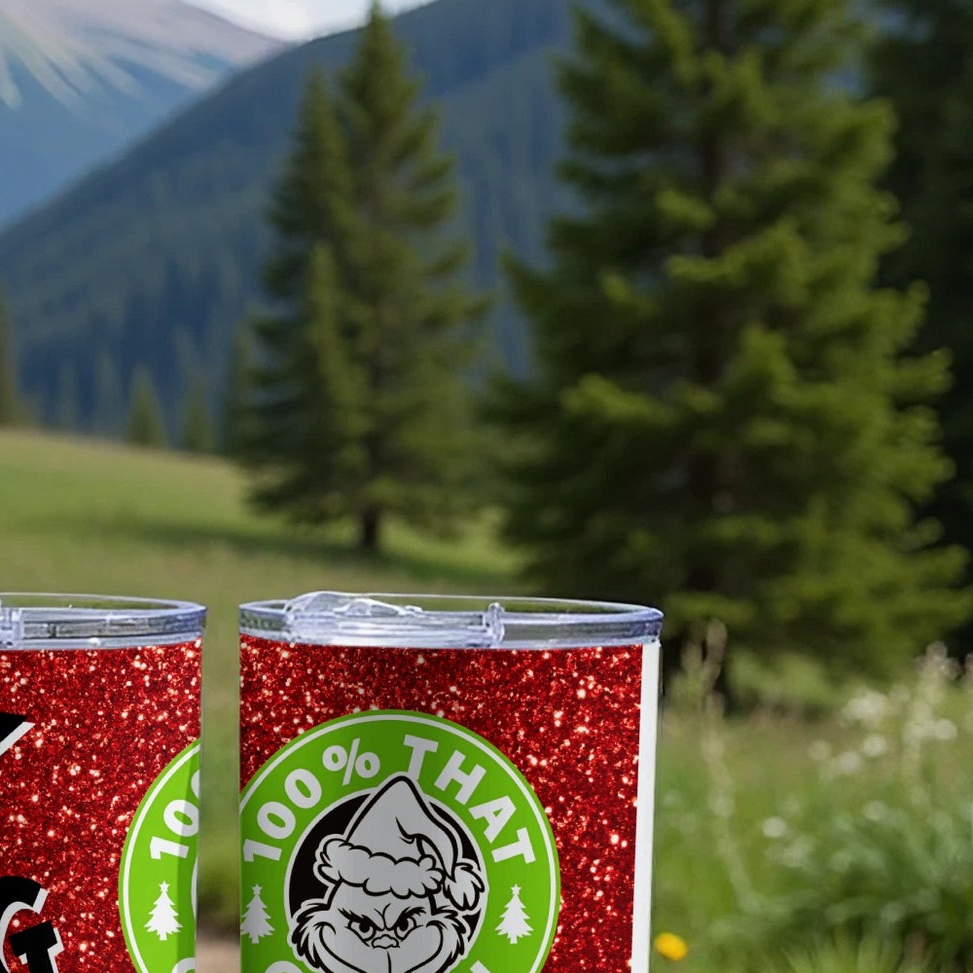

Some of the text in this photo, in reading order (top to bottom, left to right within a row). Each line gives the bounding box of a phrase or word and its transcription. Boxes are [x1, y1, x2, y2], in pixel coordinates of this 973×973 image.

[149, 768, 200, 860] 10
[243, 734, 537, 864] 100% THAT
